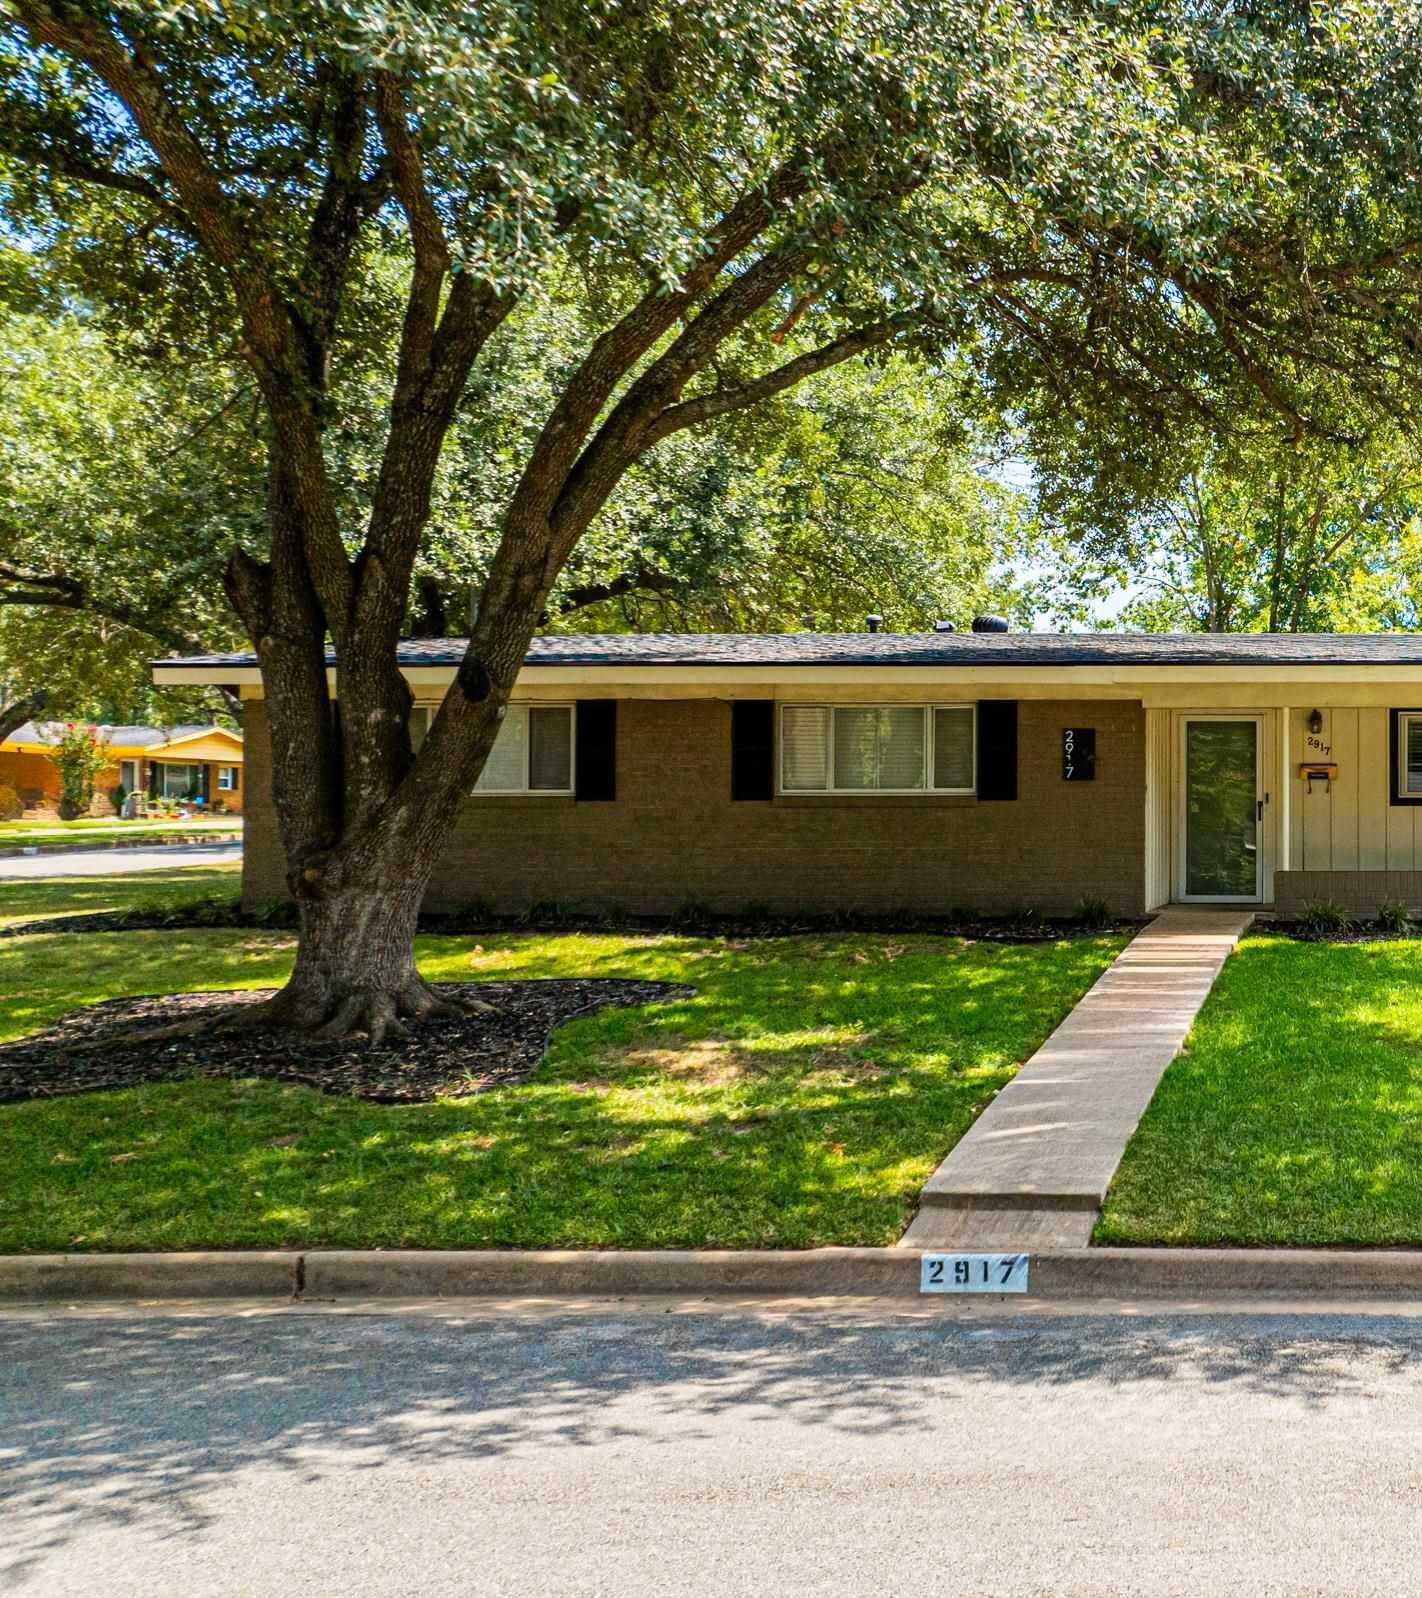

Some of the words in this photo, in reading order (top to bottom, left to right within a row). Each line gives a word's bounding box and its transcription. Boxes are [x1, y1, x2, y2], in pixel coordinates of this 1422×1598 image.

[1064, 730, 1075, 779] 2917
[1307, 736, 1331, 755] 2917
[928, 1260, 1017, 1284] 2917
